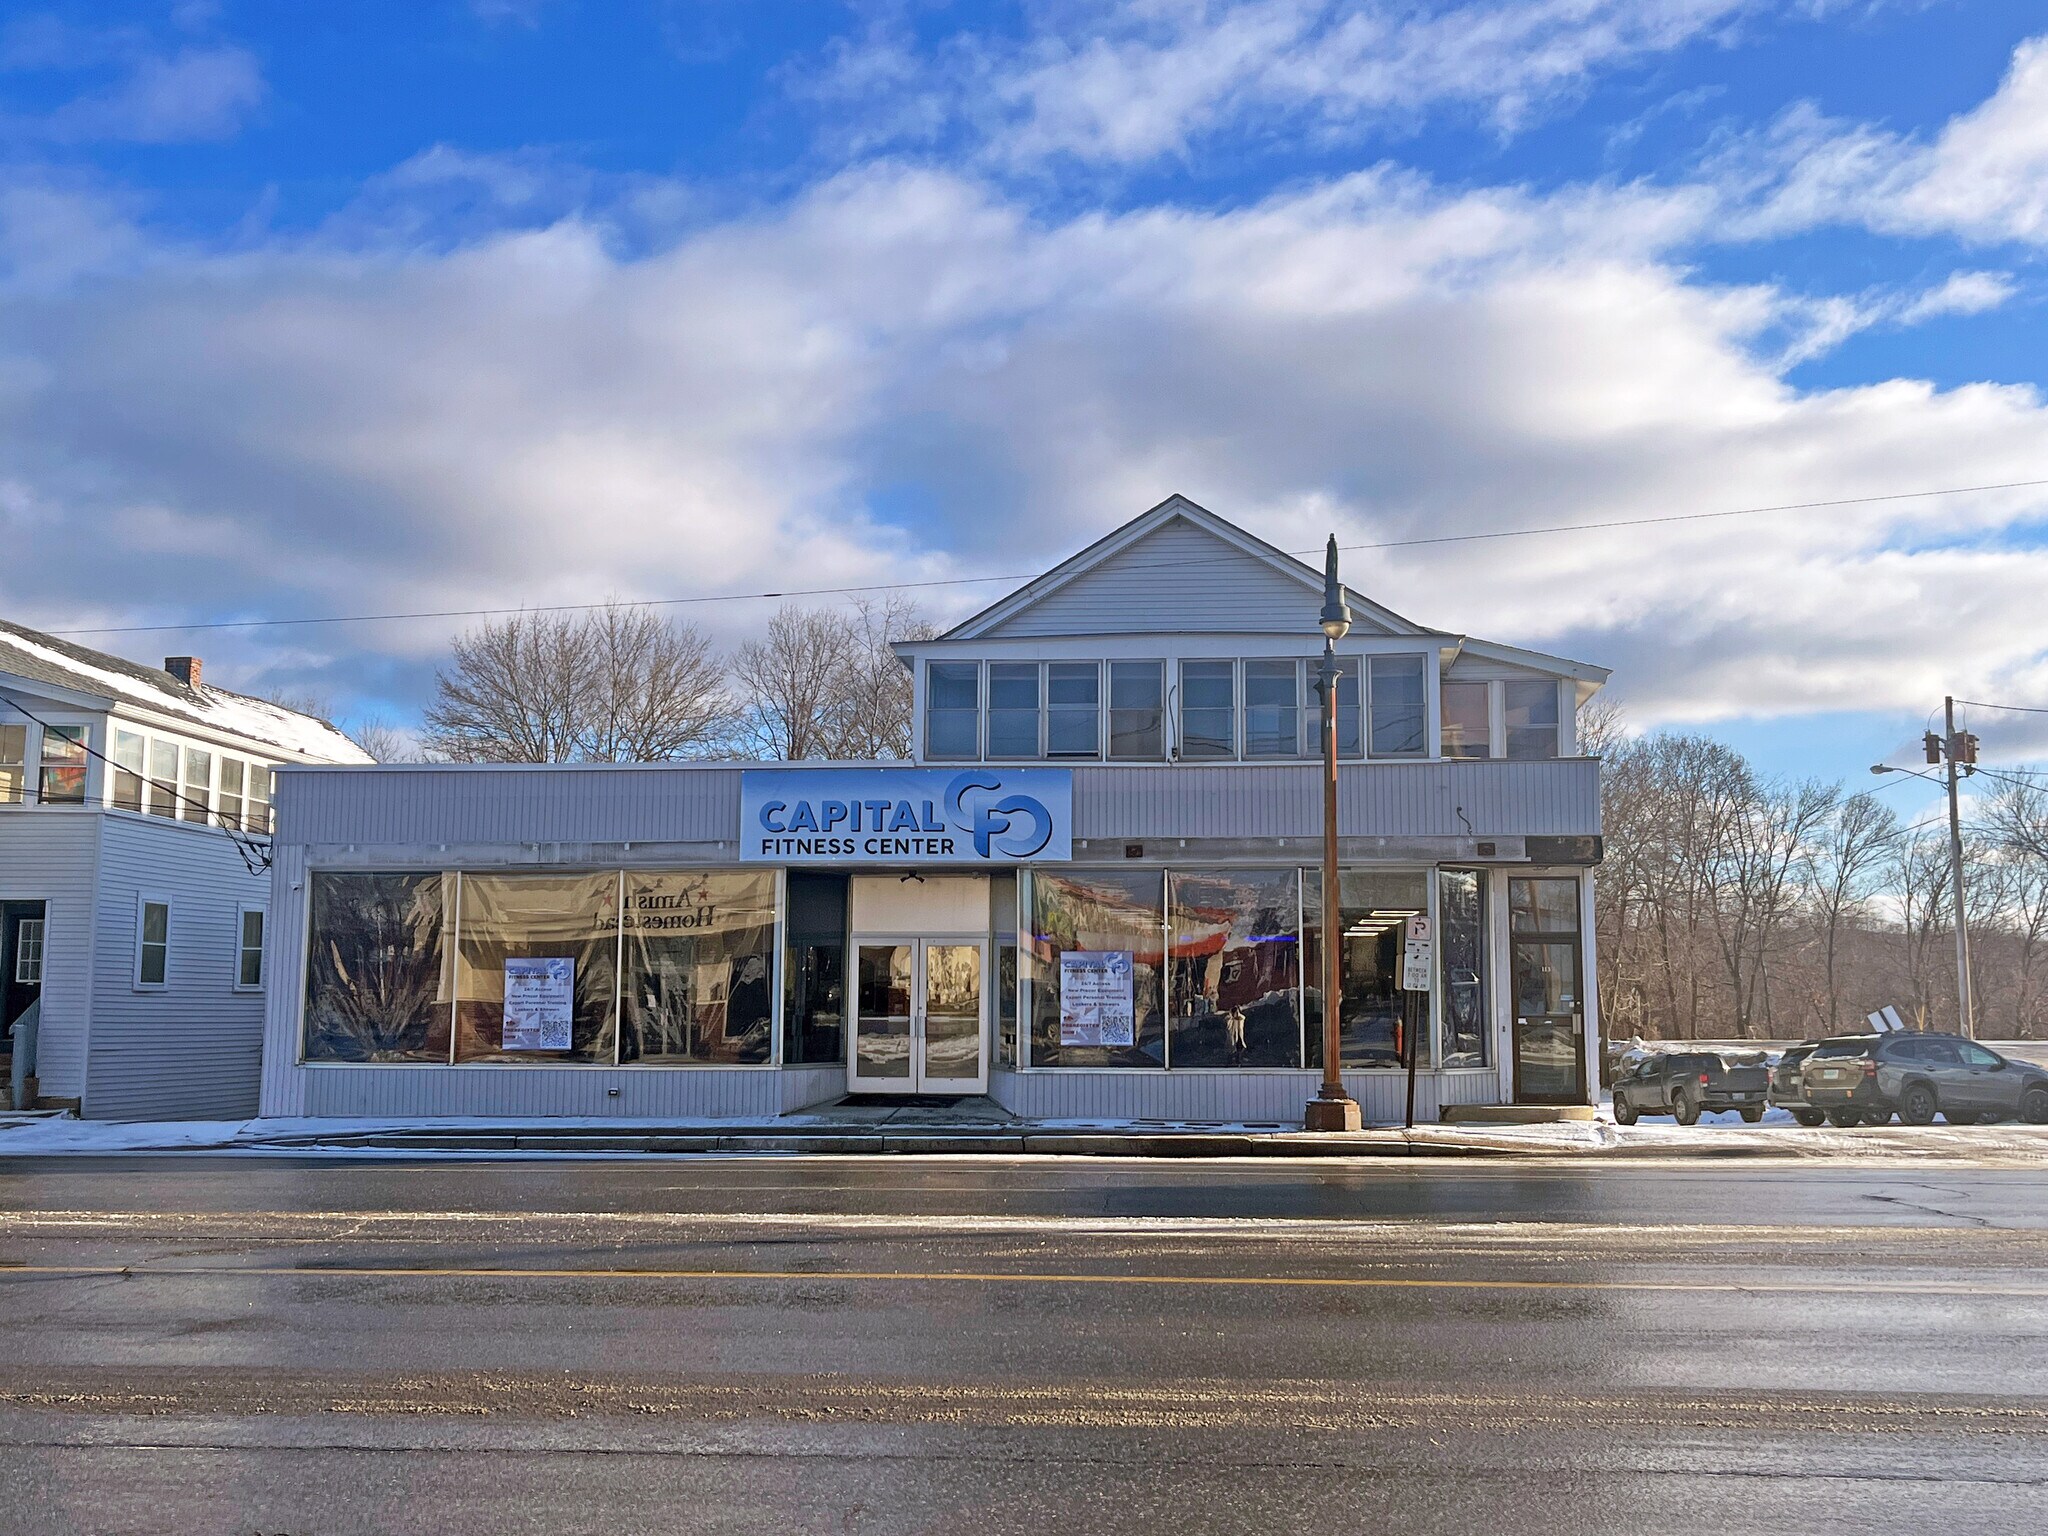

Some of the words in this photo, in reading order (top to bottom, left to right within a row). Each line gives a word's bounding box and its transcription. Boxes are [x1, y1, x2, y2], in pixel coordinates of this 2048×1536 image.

[759, 800, 945, 833] CAPITAL
[761, 838, 856, 855] FITNESS
[864, 838, 955, 855] CENTER
